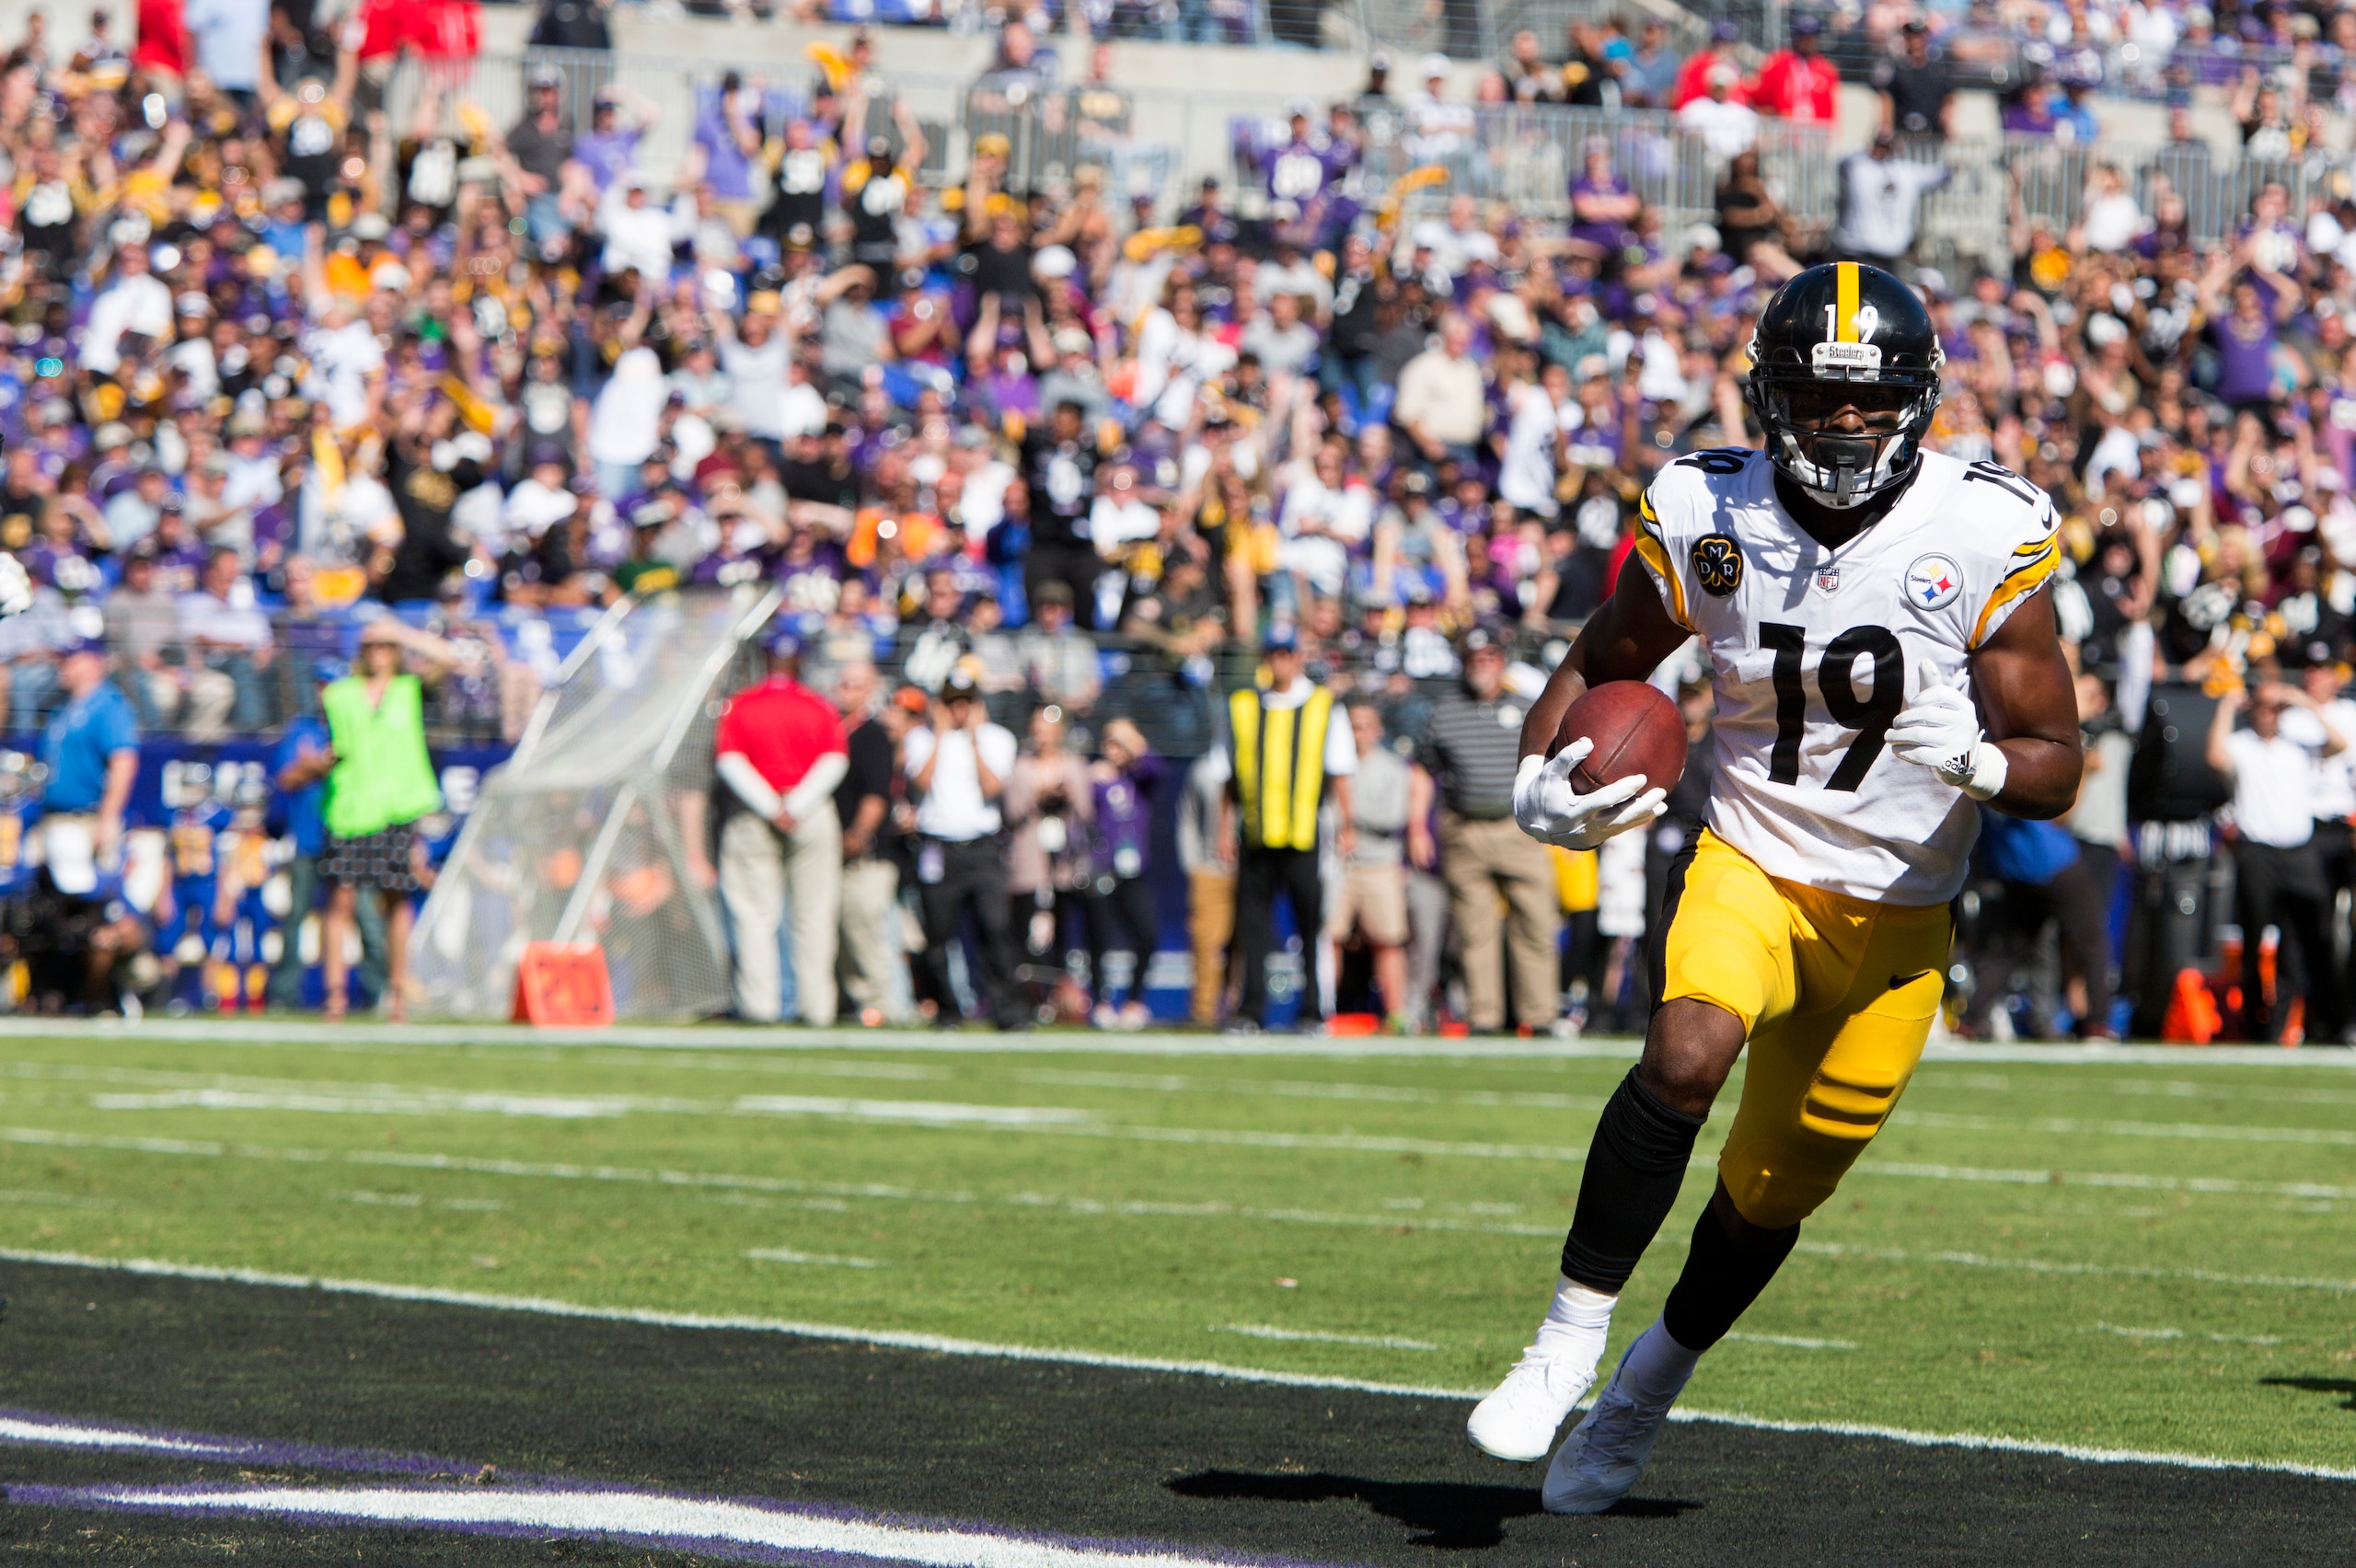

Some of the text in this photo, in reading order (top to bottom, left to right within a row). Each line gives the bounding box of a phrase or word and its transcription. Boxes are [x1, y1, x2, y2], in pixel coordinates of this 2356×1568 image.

[1824, 304, 1878, 344] 19
[1829, 345, 1865, 360] Steelers
[1962, 460, 2039, 507] 19
[1709, 546, 1723, 559] M
[1700, 561, 1734, 577] D R
[1819, 576, 1837, 589] NFL
[1911, 574, 1932, 585] Steelers
[1759, 621, 1905, 793] 19
